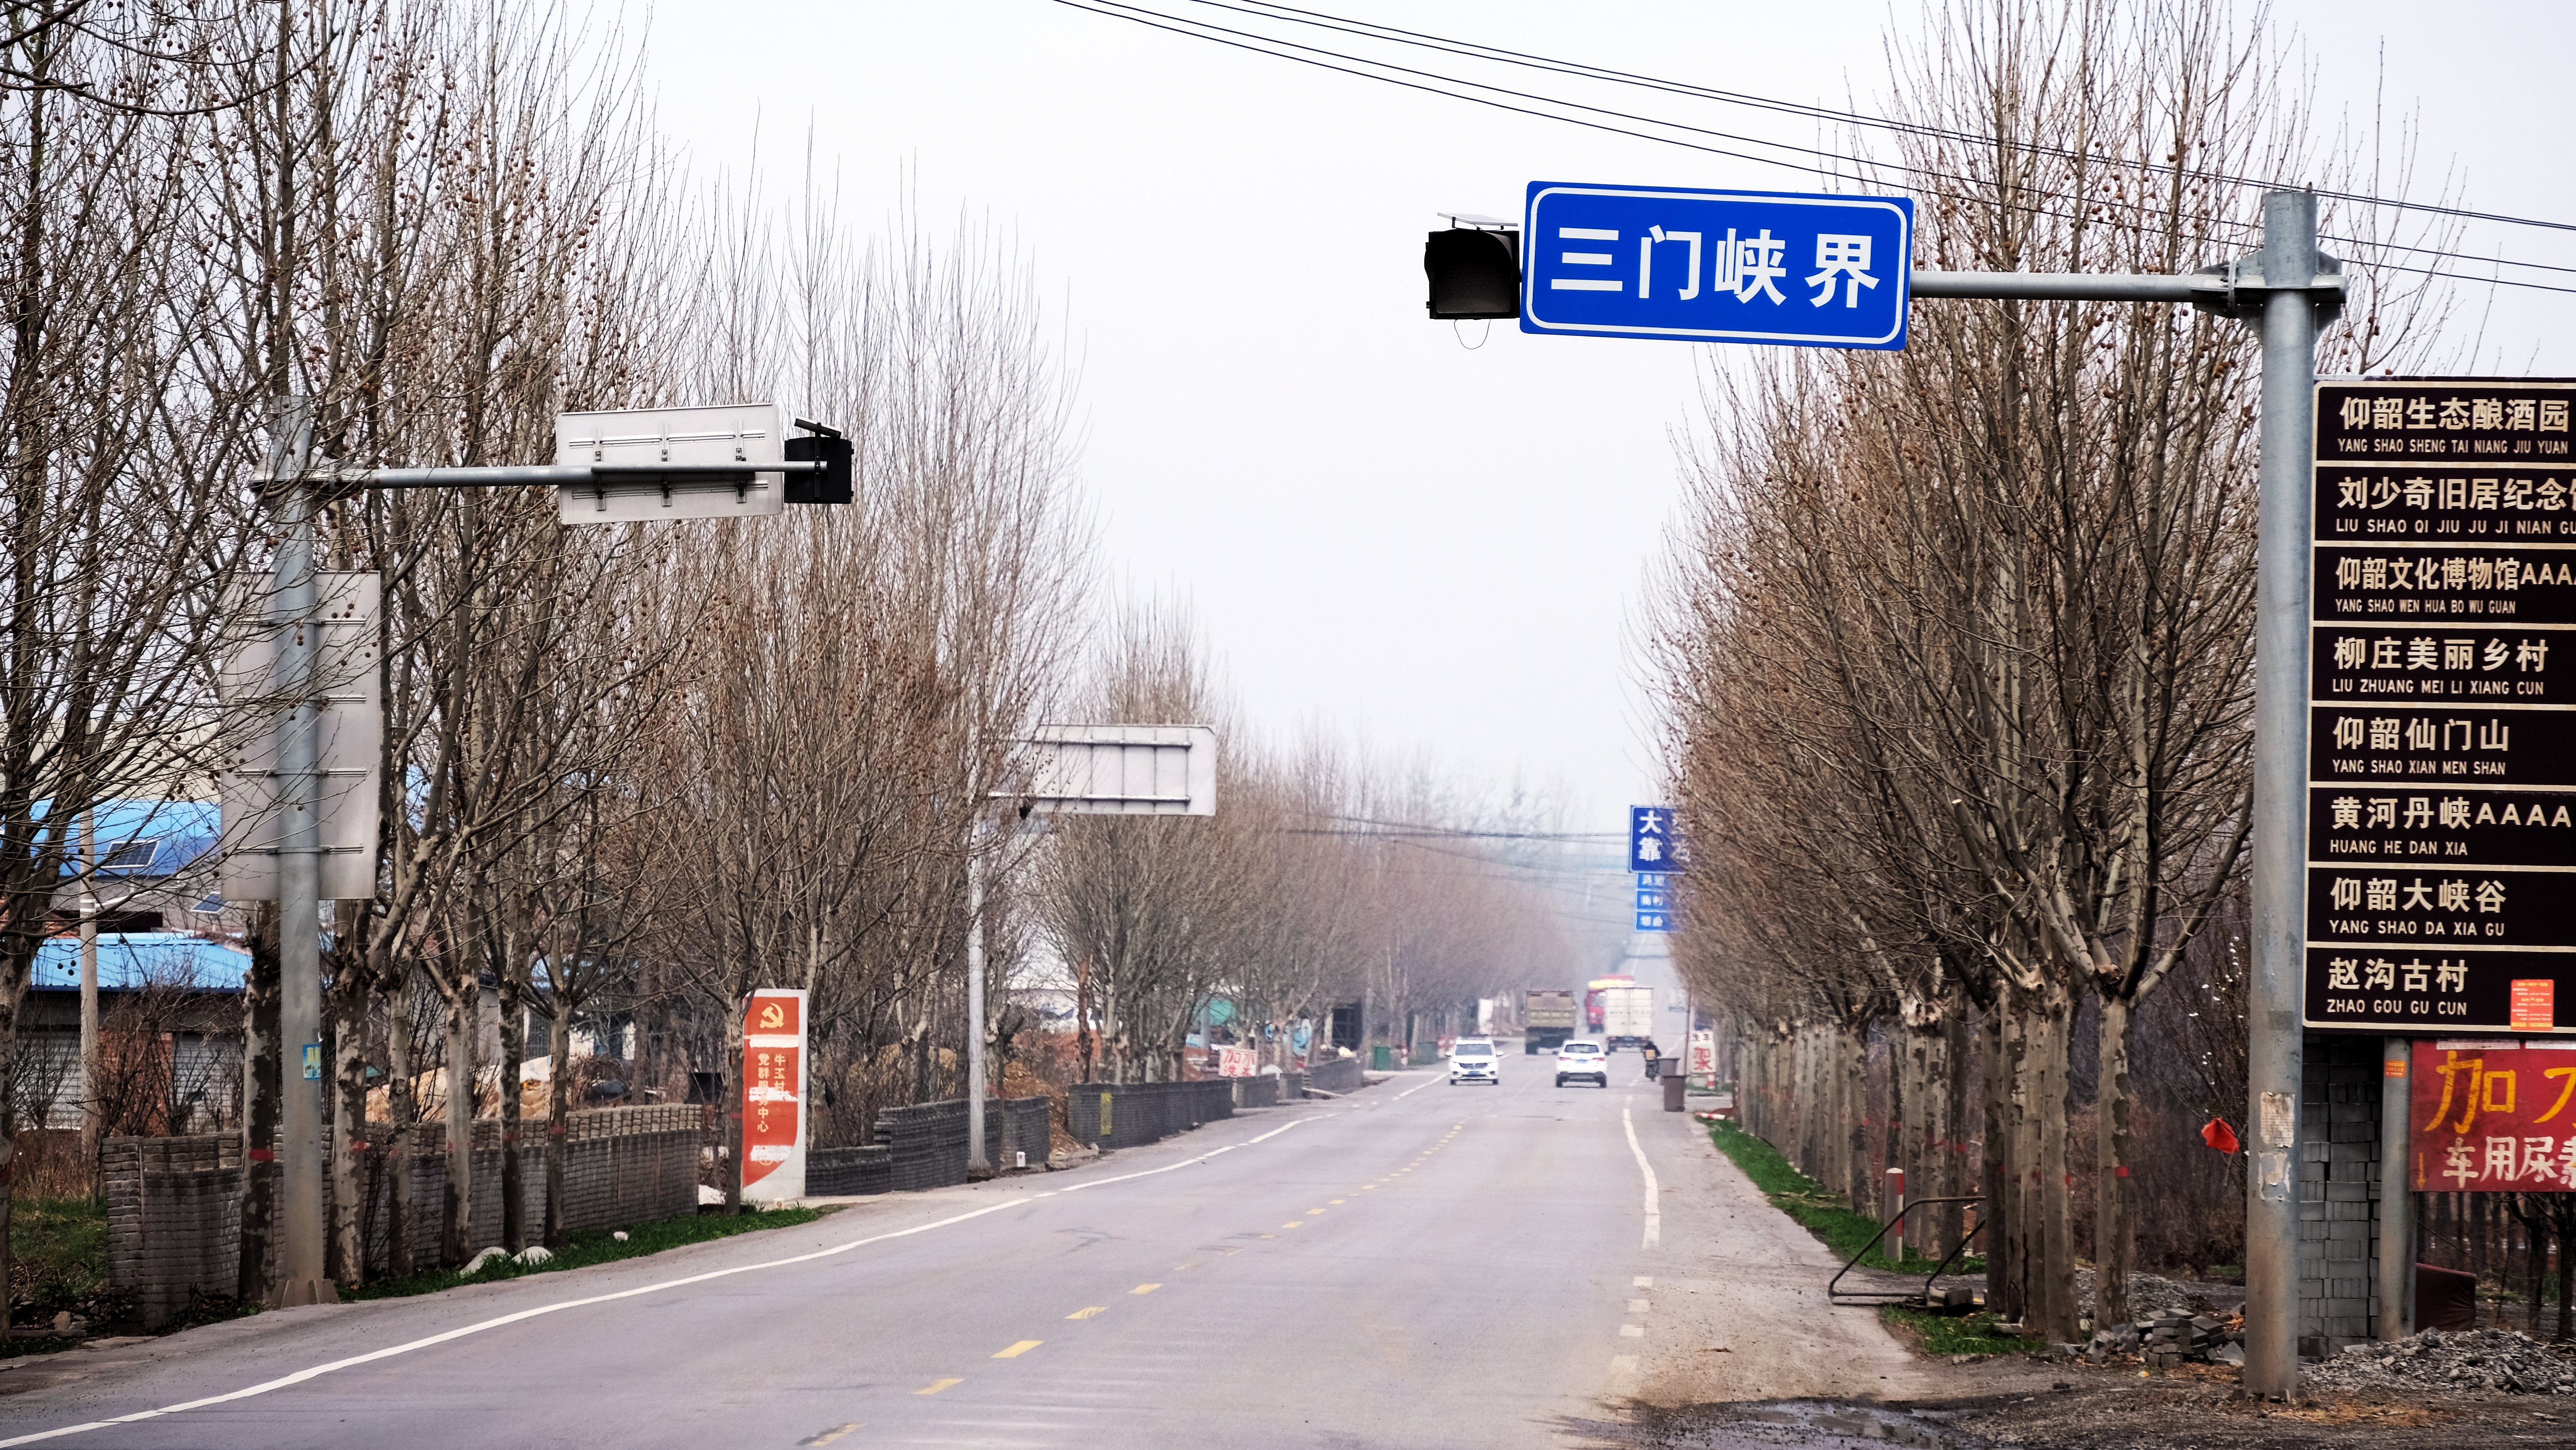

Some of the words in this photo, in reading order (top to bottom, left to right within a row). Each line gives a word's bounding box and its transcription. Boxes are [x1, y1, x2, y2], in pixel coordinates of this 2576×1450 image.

[1551, 224, 1880, 308] 三门峡界
[2339, 397, 2569, 432] 仰韶生态酿酒园
[2338, 438, 2368, 452] YANG
[2374, 438, 2404, 452] SHAO
[2410, 439, 2446, 453] SHENG
[2451, 440, 2468, 453] TAI
[2474, 440, 2508, 453] NIANG
[2513, 440, 2531, 453] JIU
[2537, 440, 2568, 454] YUAN
[2337, 476, 2576, 511] 刘少奇旧居纪念
[2336, 518, 2358, 532] LIU
[2367, 519, 2407, 533] SHAO
[2415, 520, 2428, 533] QI
[2436, 520, 2460, 533] JIU
[2468, 520, 2487, 533] JU
[2495, 520, 2508, 534] JI
[2517, 520, 2551, 534] NIAN
[2335, 556, 2576, 591] 仰韶文化博物馆AAA
[2335, 599, 2362, 612] YANG
[2367, 599, 2395, 613] SHAO
[2399, 599, 2420, 613] WEN
[2425, 599, 2446, 613] HUA
[2451, 600, 2464, 613] BO
[2469, 600, 2483, 613] WU
[2489, 600, 2516, 614] GUAN
[2333, 636, 2549, 672] 柳庄美丽乡村
[2333, 678, 2353, 692] LIU
[2360, 679, 2414, 693] ZHUANG
[2421, 680, 2444, 693] MEI
[2451, 680, 2462, 694] LI
[2470, 680, 2510, 695] XIANG
[2517, 681, 2544, 695] CUN
[2332, 716, 2509, 751] 仰韶仙门山
[2332, 759, 2364, 773] YANG
[2371, 760, 2403, 774] SHAO
[2408, 760, 2436, 774] XIAN
[2442, 760, 2467, 774] MEN
[2473, 761, 2505, 775] SHAN
[2330, 839, 2376, 853] HUANG
[2384, 840, 2402, 854] HE
[2409, 840, 2438, 855] DAN
[2445, 841, 2468, 856] XIA
[2330, 877, 2507, 913] 仰韶大峡谷
[2329, 920, 2369, 934] YANG
[2378, 920, 2417, 934] SHAO
[2425, 921, 2446, 935] DA
[2453, 922, 2478, 936] XIA
[2485, 923, 2505, 936] GU
[2328, 957, 2468, 993] 赵沟古村
[2327, 999, 2365, 1013] ZHAO
[2373, 999, 2402, 1013] GOU
[2410, 1000, 2429, 1014] GU
[2438, 1001, 2467, 1015] CUN
